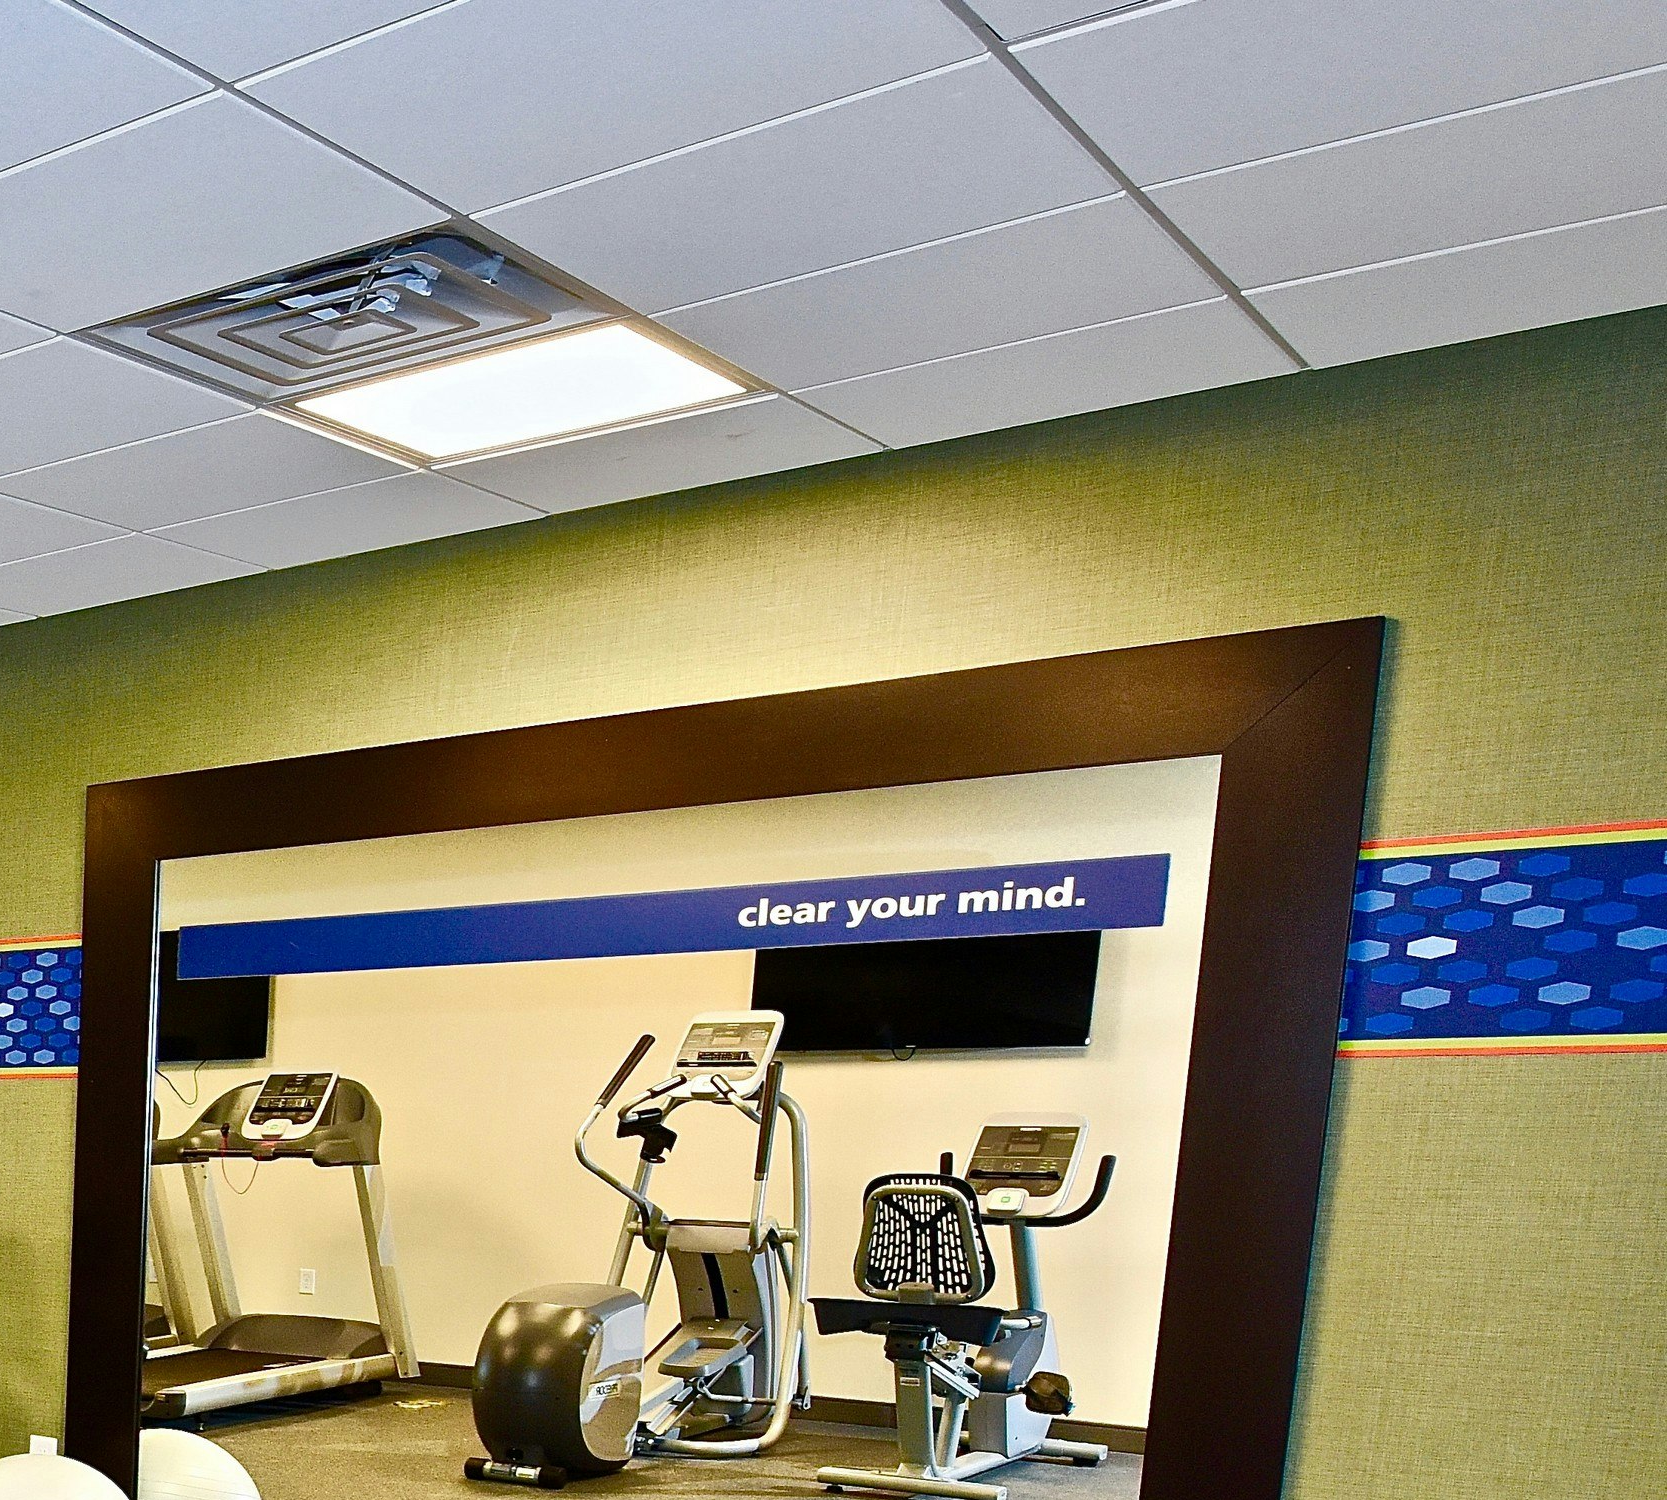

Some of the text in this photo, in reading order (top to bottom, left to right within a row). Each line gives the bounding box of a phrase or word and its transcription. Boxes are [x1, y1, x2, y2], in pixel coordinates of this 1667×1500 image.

[737, 876, 1085, 928] clear your mind.
